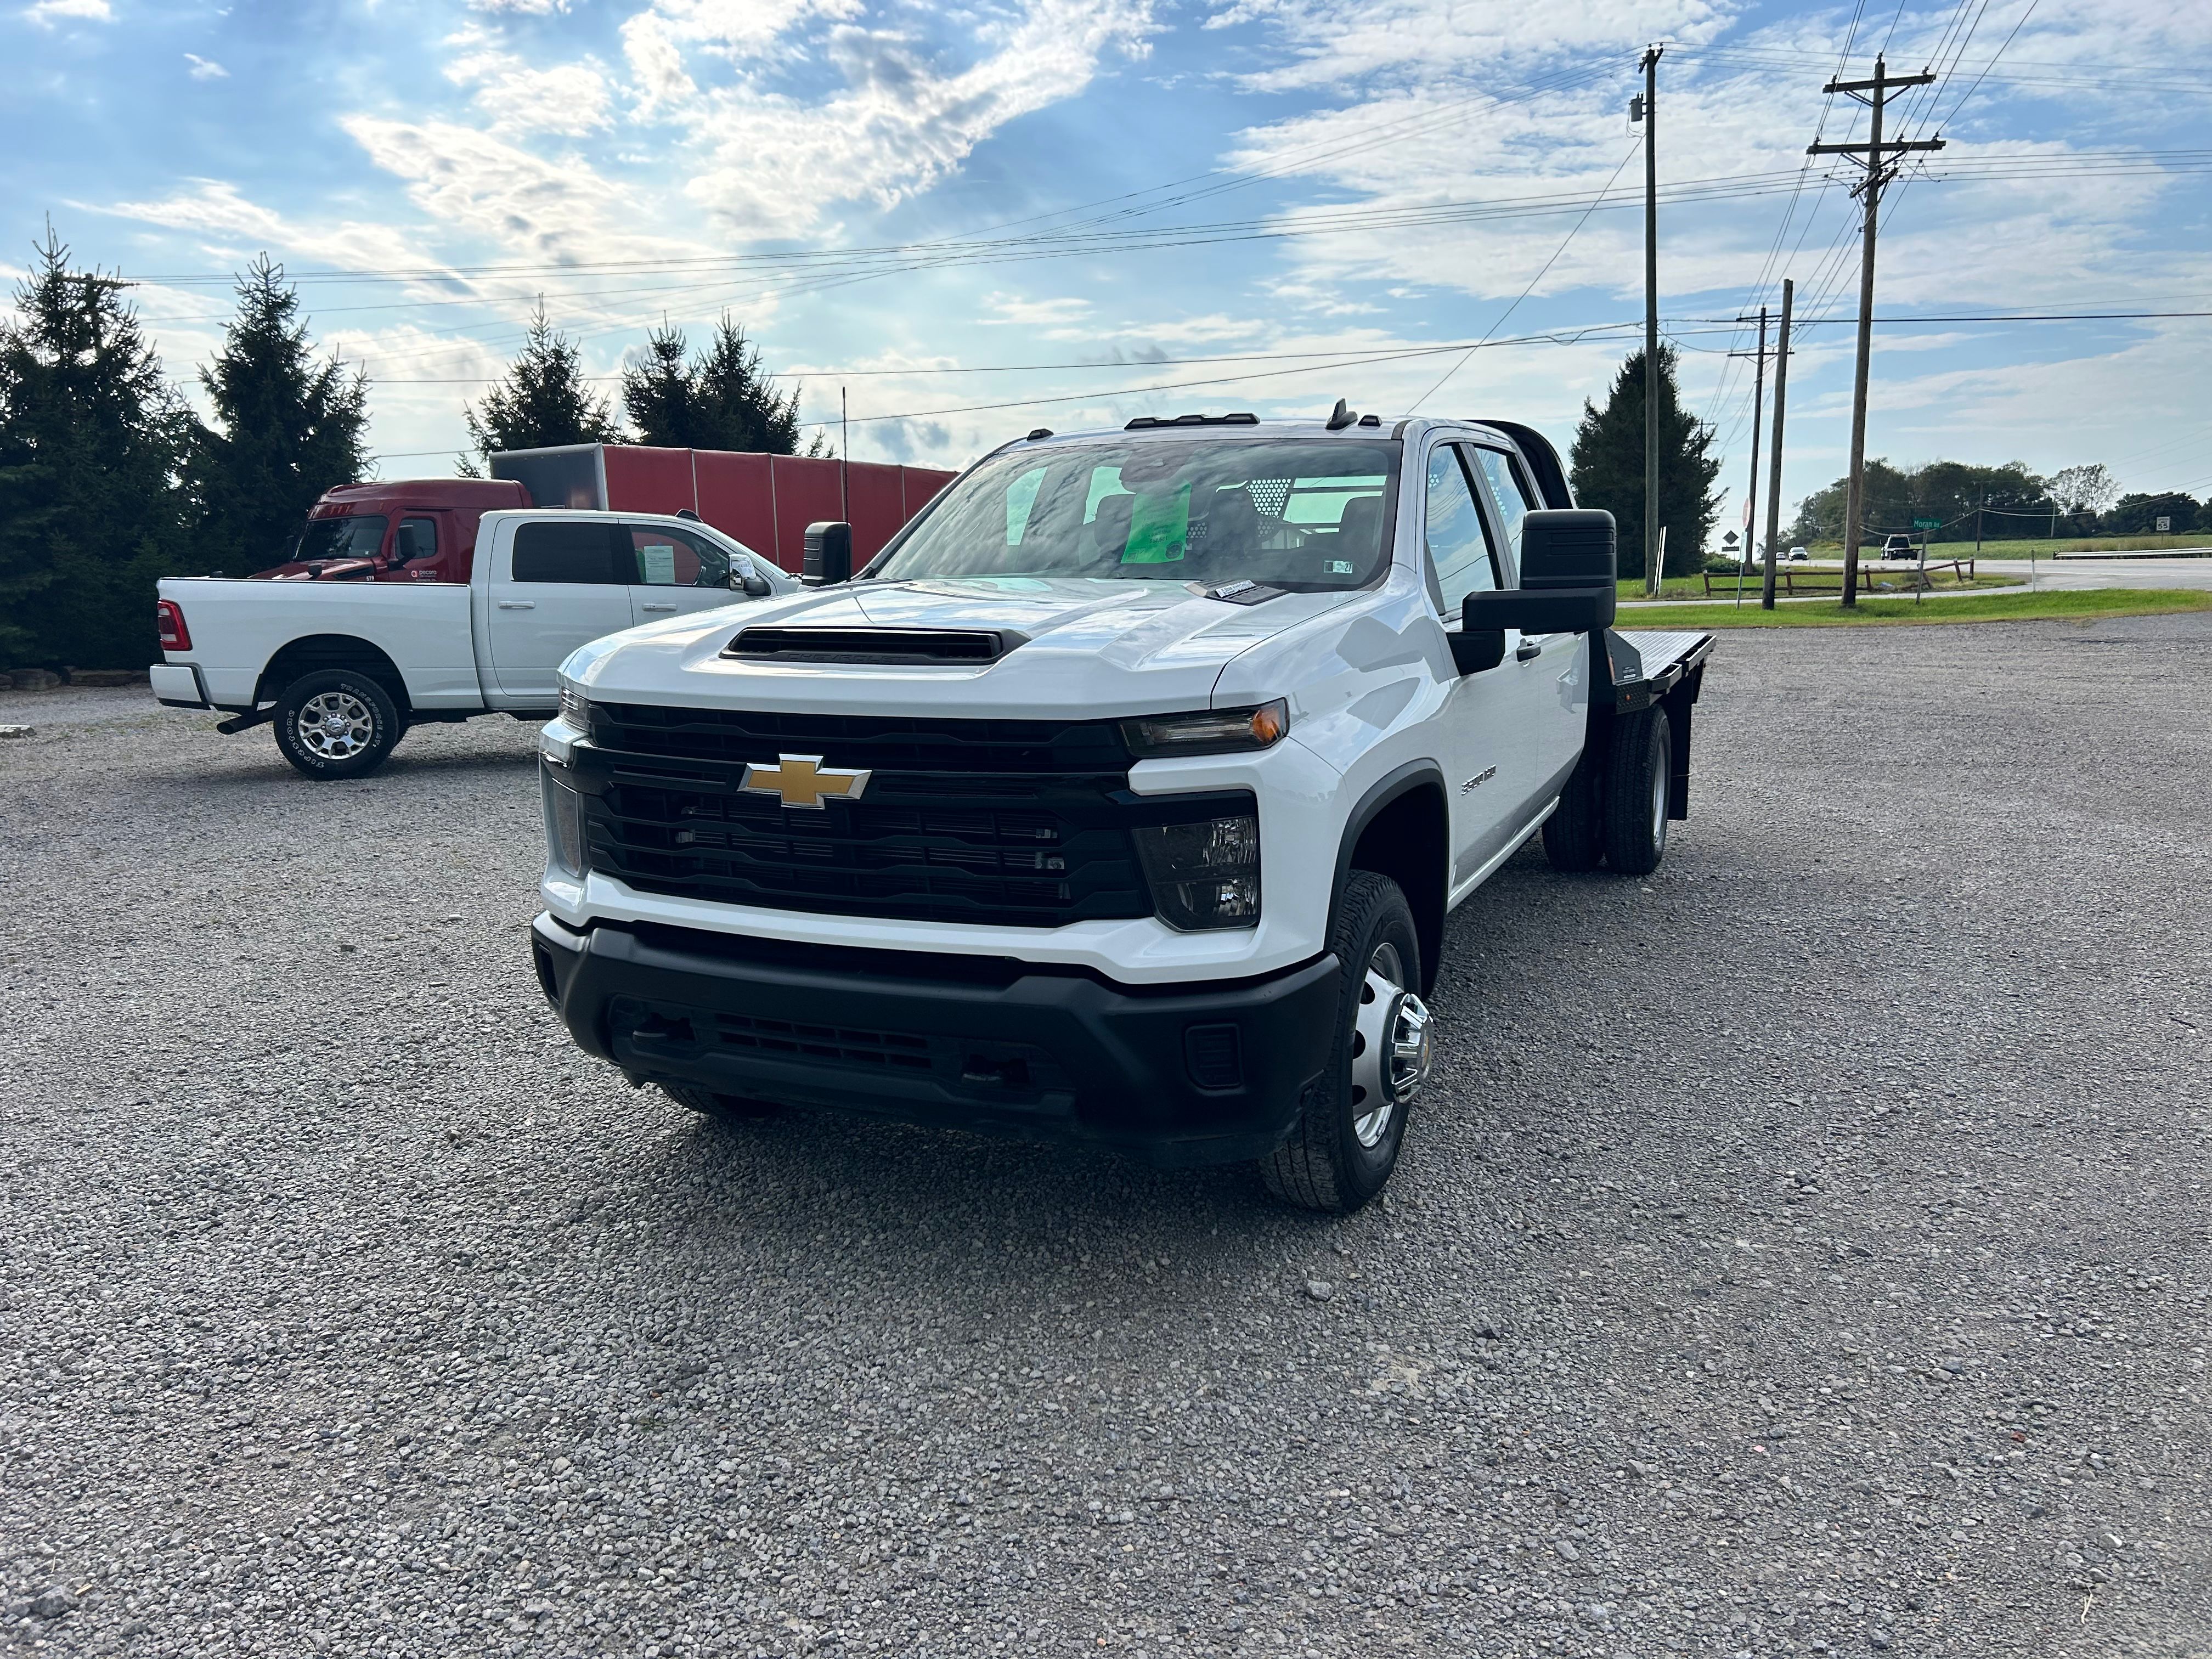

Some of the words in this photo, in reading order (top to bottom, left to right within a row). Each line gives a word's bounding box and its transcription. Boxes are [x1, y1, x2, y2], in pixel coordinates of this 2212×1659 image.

[1345, 562, 1352, 572] 27
[787, 653, 909, 662] CHEVROLET
[341, 683, 383, 730] TRANSFORCE
